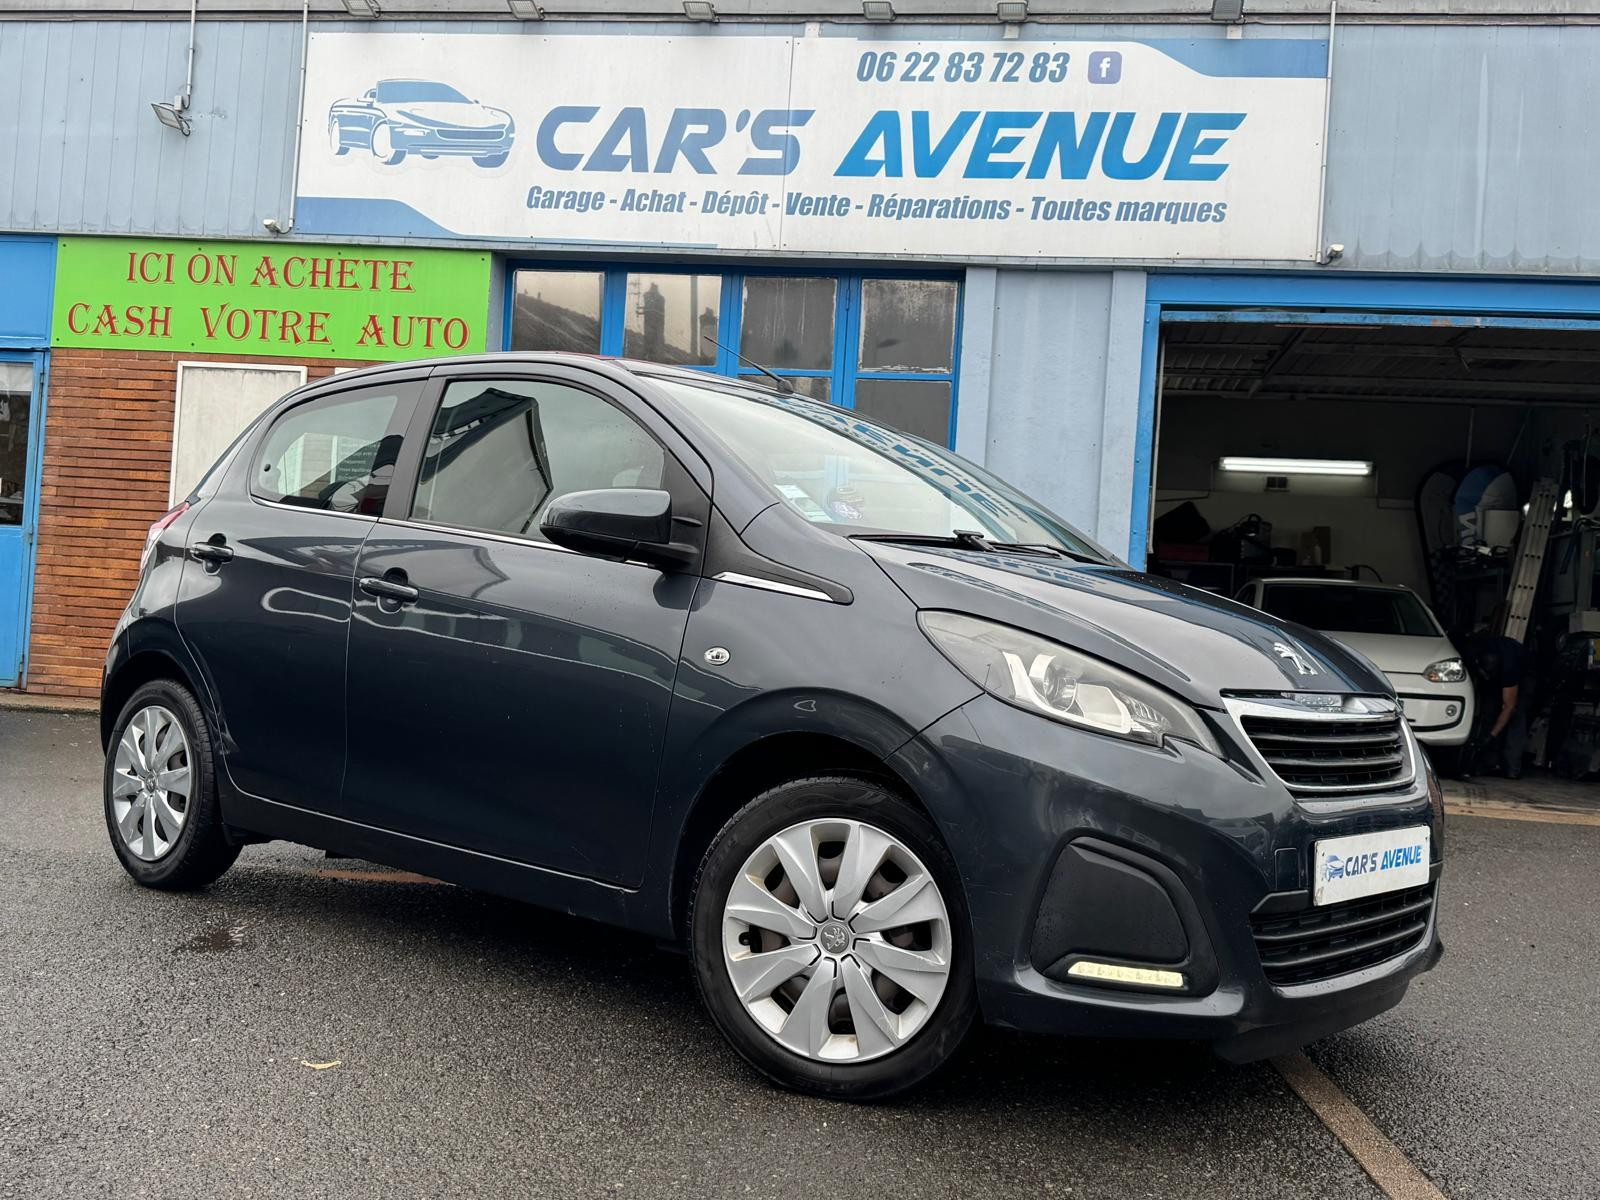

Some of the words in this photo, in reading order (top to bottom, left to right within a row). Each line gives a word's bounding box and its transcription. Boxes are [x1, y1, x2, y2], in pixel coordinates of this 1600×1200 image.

[857, 52, 896, 81] 06
[900, 52, 939, 81] 22
[945, 52, 984, 83] 83
[991, 53, 1024, 82] 72
[1029, 52, 1070, 83] 83
[536, 106, 816, 177] CAR'S
[834, 109, 1247, 182] AVENUE
[527, 185, 605, 212] Garage
[620, 188, 687, 213] Achat
[702, 190, 768, 216] Dépôt
[786, 193, 850, 217] Vente
[867, 194, 1011, 221] Réparations
[1031, 197, 1112, 222] Toutes
[1115, 202, 1227, 225] marques
[127, 252, 175, 284] ICI
[187, 253, 237, 286] ON
[250, 255, 415, 293] ACHETE
[67, 302, 173, 338] CASH
[200, 302, 332, 345] VOTRE
[356, 314, 470, 350] AUTO
[1345, 852, 1378, 876] CAR'S
[1380, 845, 1423, 870] AVENUE
